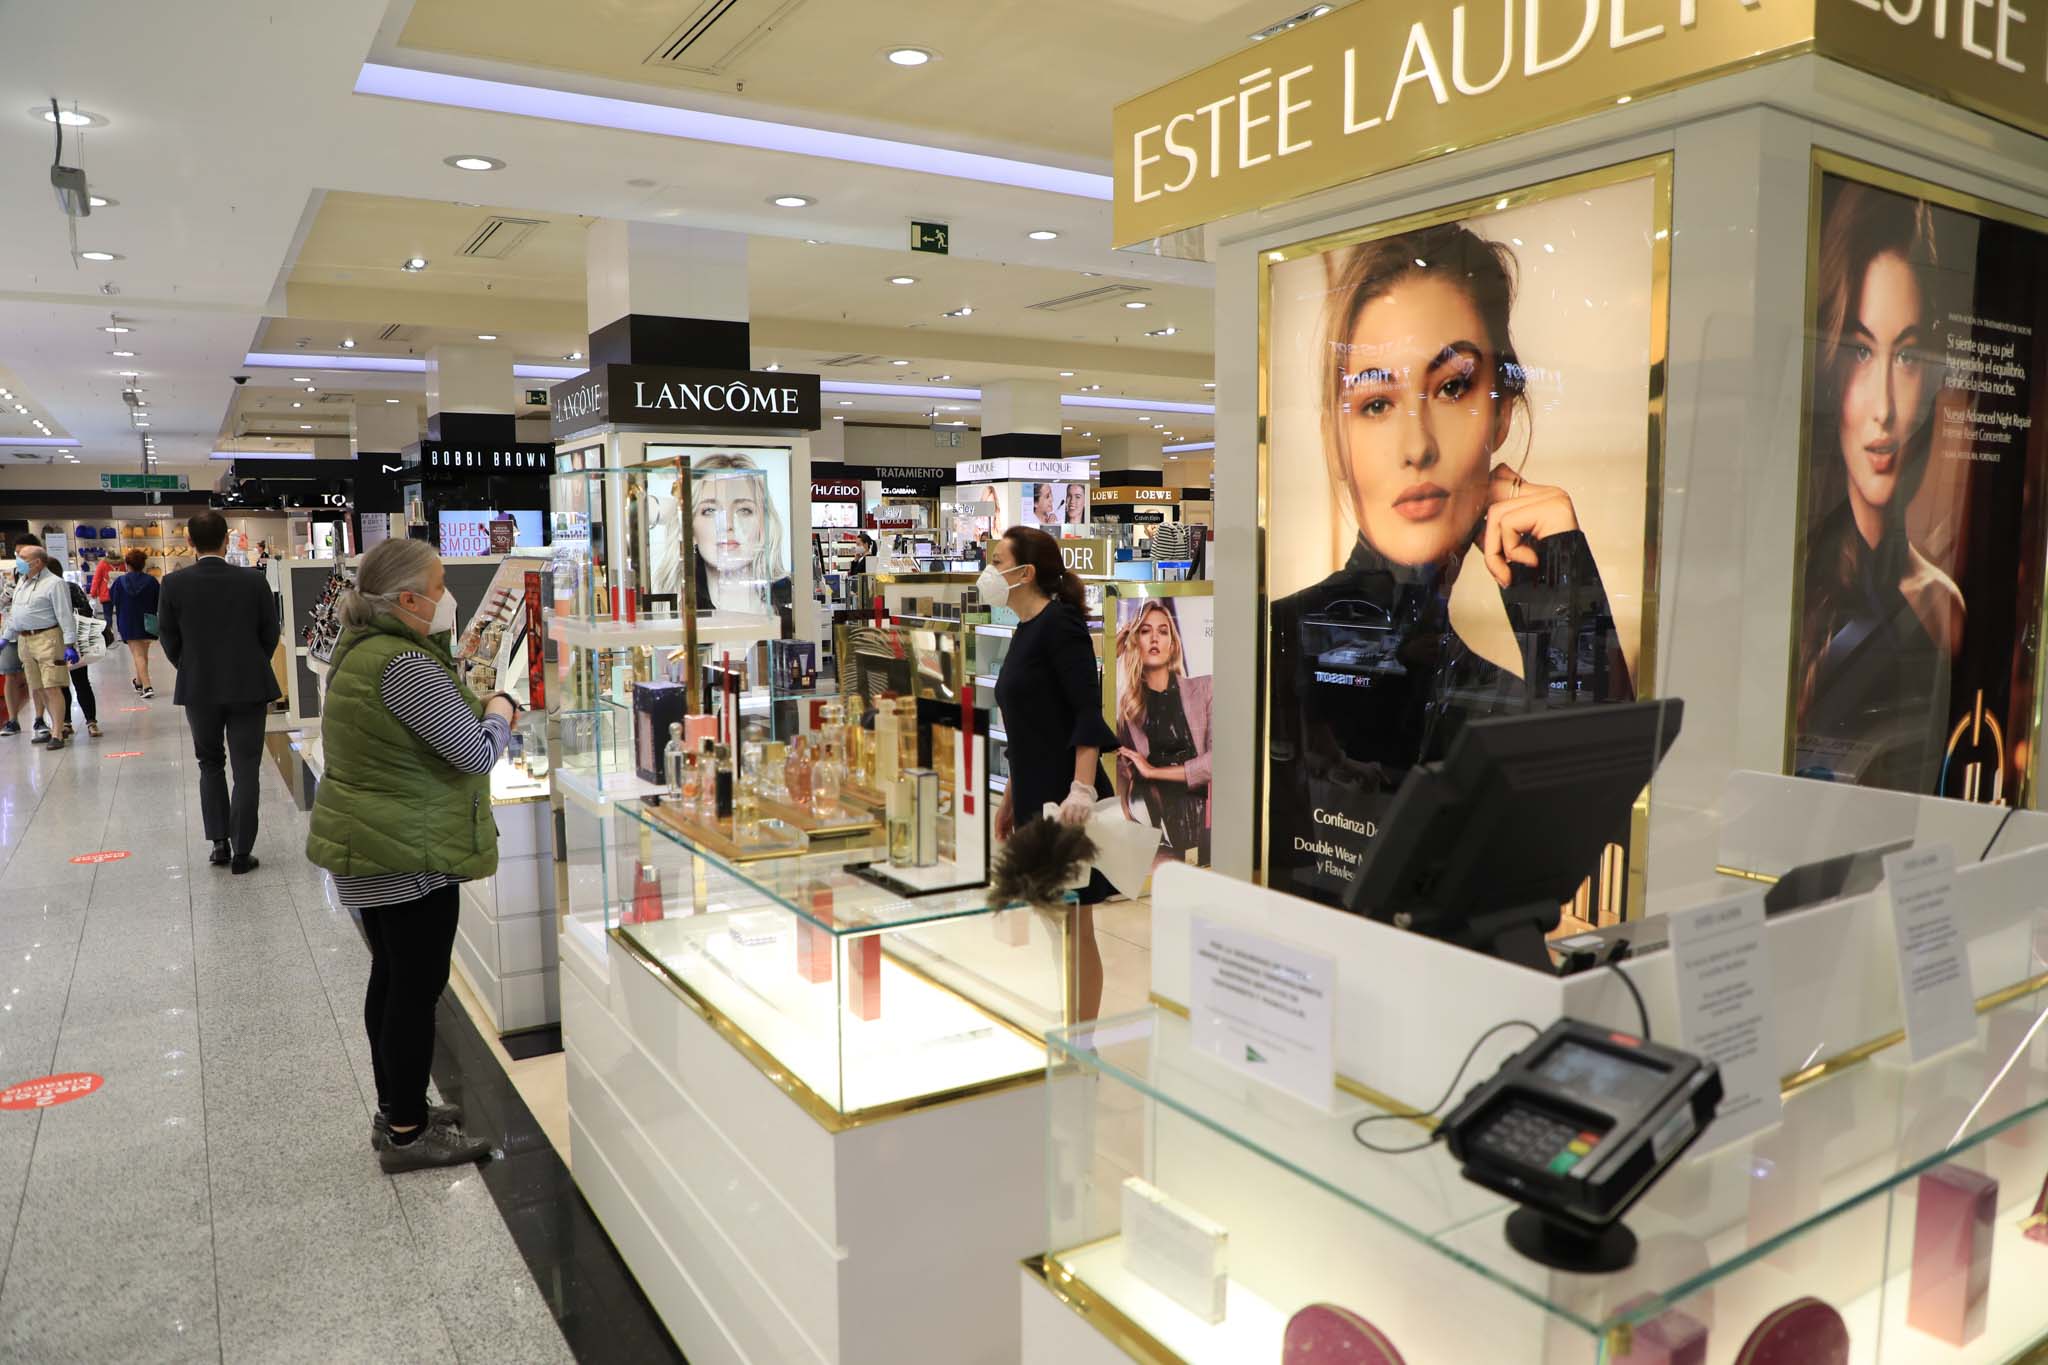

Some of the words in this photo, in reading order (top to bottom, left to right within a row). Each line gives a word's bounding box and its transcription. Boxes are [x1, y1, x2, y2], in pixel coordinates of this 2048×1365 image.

[1344, 0, 1760, 136] LAUD
[634, 381, 799, 415] LANCÔME
[431, 450, 481, 467] BOBBI
[494, 455, 547, 468] BROWN
[1028, 461, 1072, 474] CLINIQUE
[876, 467, 944, 479] TRATAMIENTO
[1092, 490, 1119, 500] LOEWE
[1135, 490, 1172, 500] LOEWE
[440, 537, 488, 552] SMOOT
[1062, 547, 1093, 570] DER
[1314, 808, 1365, 835] Confianza
[1366, 821, 1378, 837] D
[1294, 836, 1334, 857] Double
[1335, 845, 1357, 865] Wear
[1316, 861, 1323, 875] y
[1325, 860, 1355, 882] Flawles
